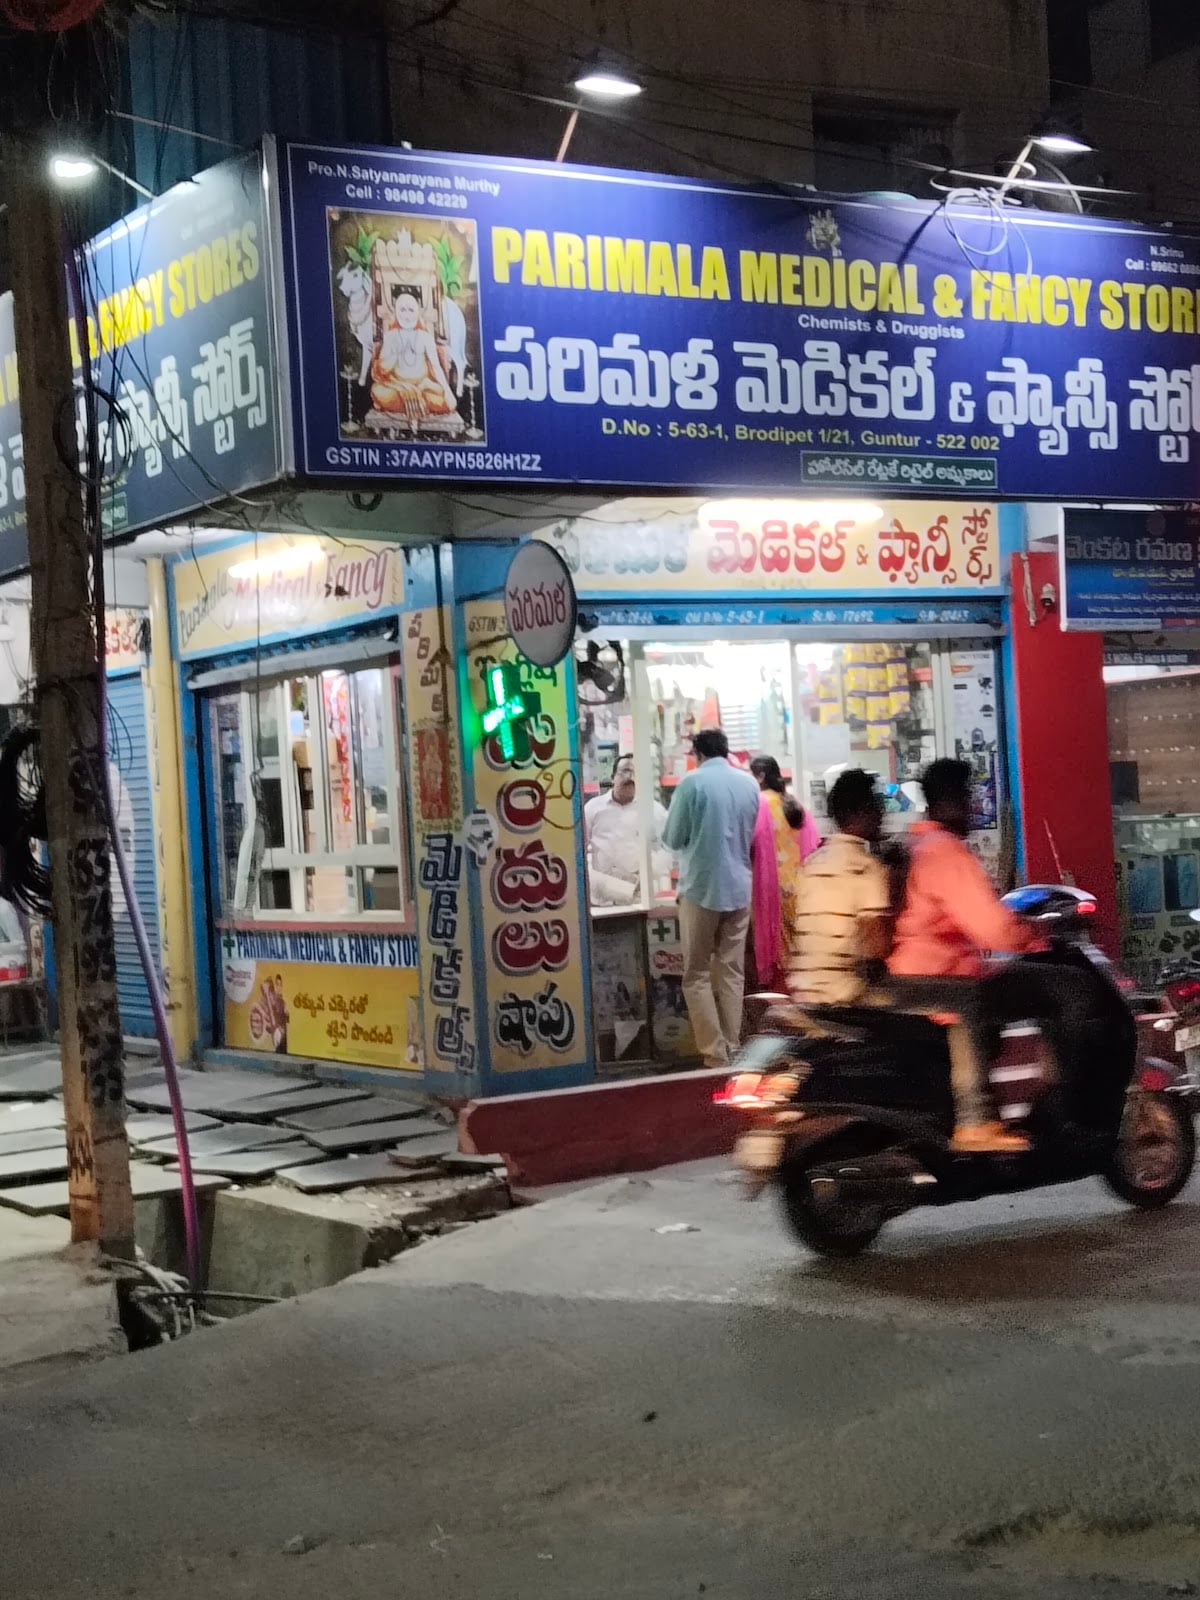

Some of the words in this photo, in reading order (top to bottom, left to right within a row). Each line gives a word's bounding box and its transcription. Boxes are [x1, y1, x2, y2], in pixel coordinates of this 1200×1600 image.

[346, 184, 372, 199] Cell
[454, 175, 501, 197] Murthy
[98, 269, 165, 353] FANCY
[168, 220, 260, 318] STORES
[491, 226, 731, 300] PARIMALA
[740, 250, 925, 316] MEDICAL
[933, 274, 963, 318] &
[971, 269, 1092, 327] FANCY
[798, 313, 871, 333] Chemists
[876, 320, 887, 333] &
[891, 321, 965, 340] Druggists
[494, 325, 719, 410] పరిమళ
[733, 339, 937, 420] మెడికల్
[949, 382, 976, 423] &
[986, 357, 1118, 456] ఫ్యాన్సీ
[602, 418, 651, 437] D.No
[669, 421, 729, 441] 5-63-1,
[735, 425, 814, 446] Brodipet
[818, 428, 855, 446] 1/21,
[861, 430, 920, 447] Guntur
[936, 433, 968, 450] 522
[970, 435, 1000, 451] 002
[326, 447, 380, 467] GSTIN
[707, 519, 855, 574] మెడికల్
[857, 544, 868, 565] &
[878, 515, 957, 584] ఫ్యాన్సీ
[325, 551, 388, 609] Fancy
[468, 615, 498, 632] GSTIN
[237, 931, 288, 960] PARIMALA
[290, 933, 337, 963] MEDICAL
[338, 936, 347, 962] &
[348, 933, 386, 966] FANCY
